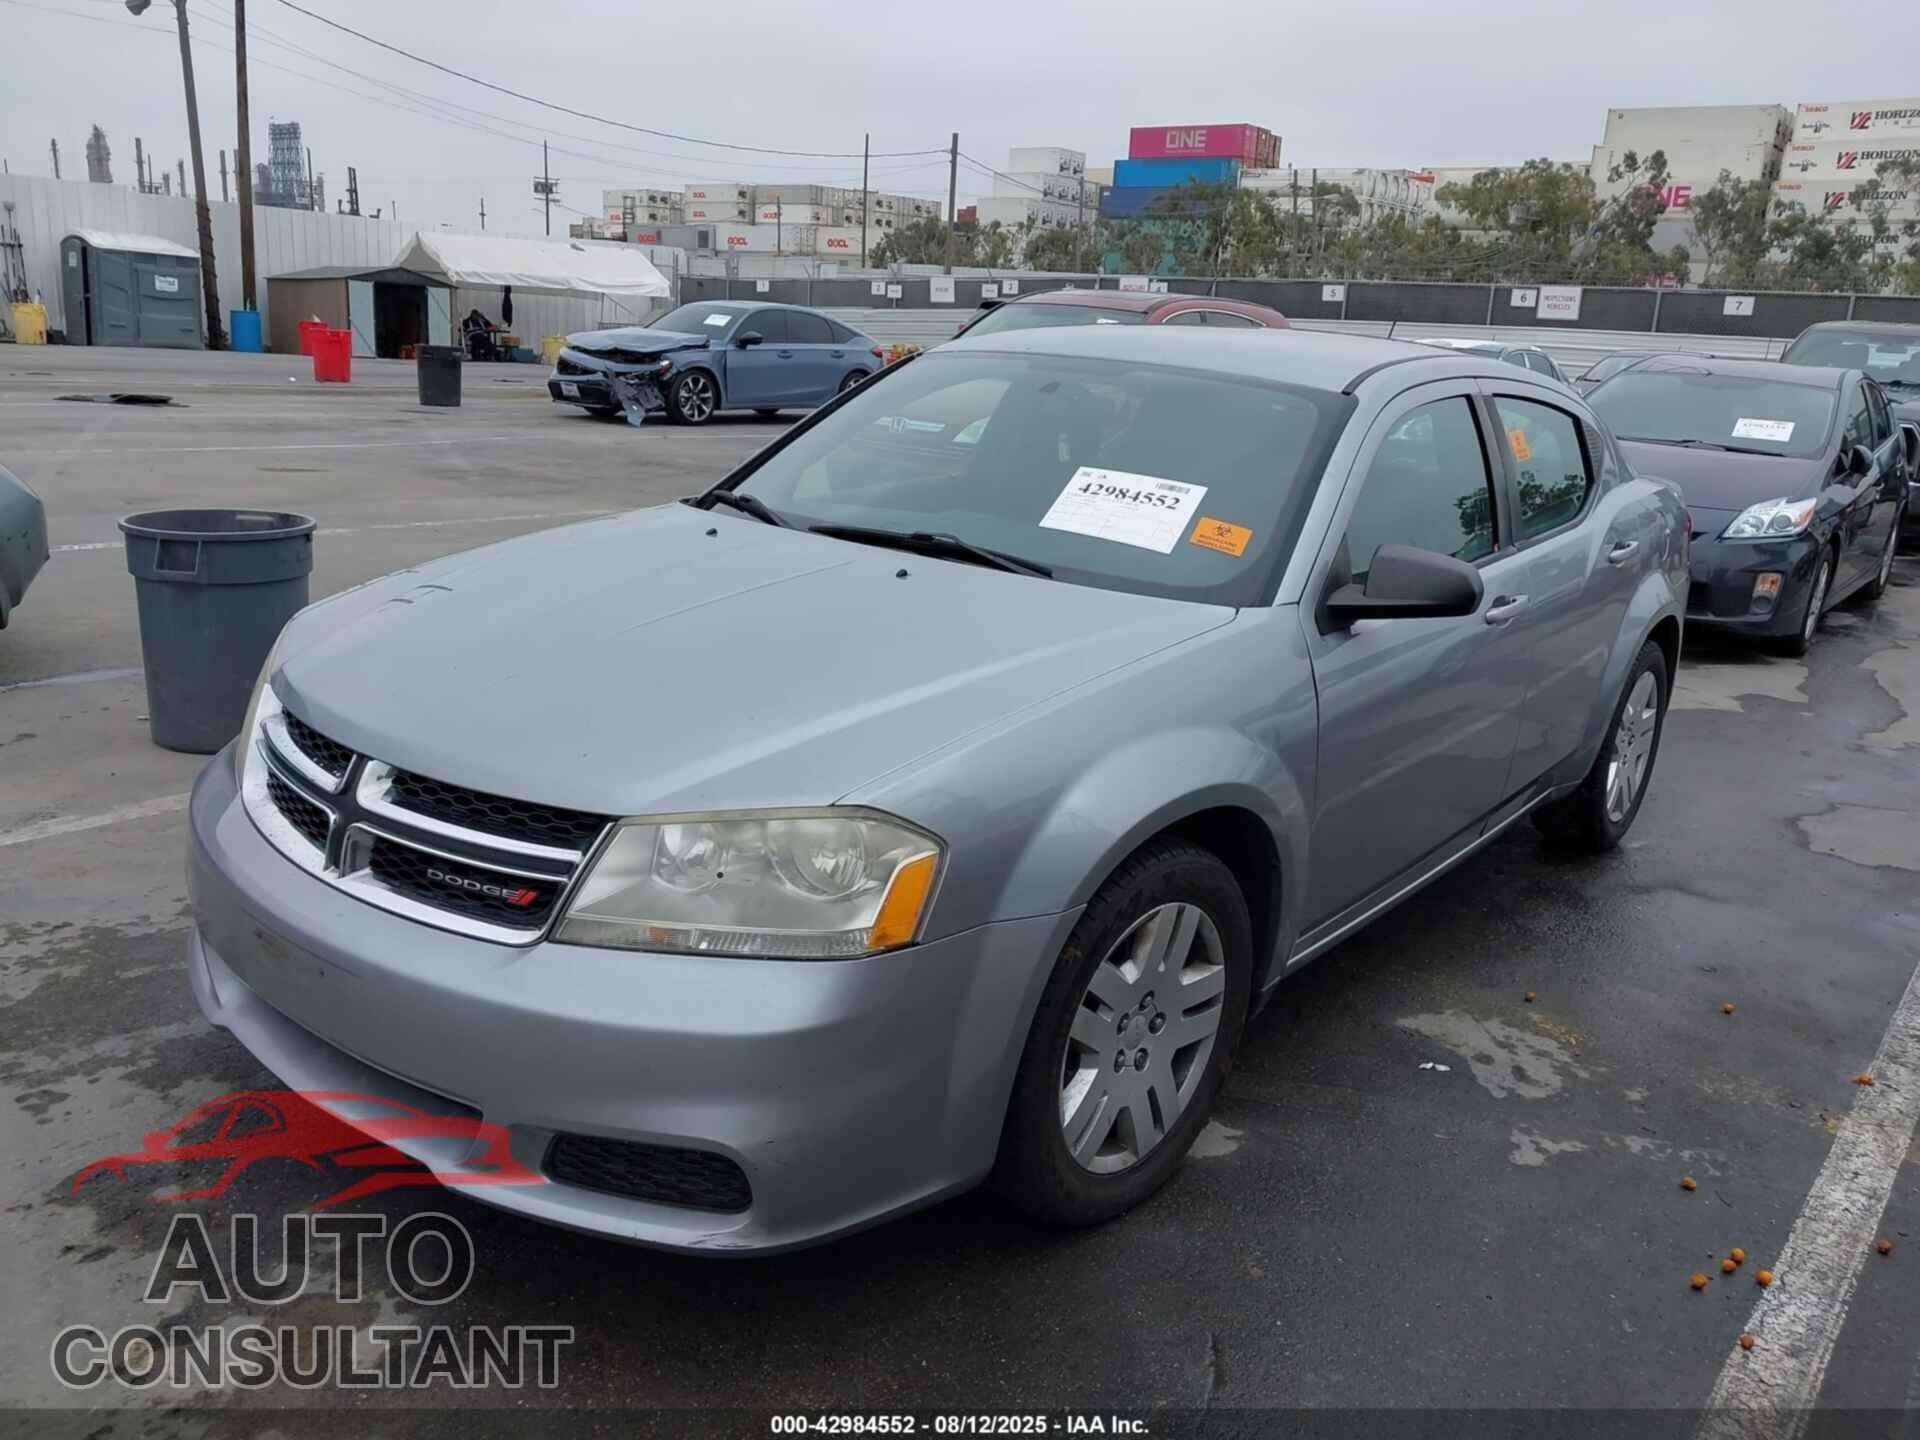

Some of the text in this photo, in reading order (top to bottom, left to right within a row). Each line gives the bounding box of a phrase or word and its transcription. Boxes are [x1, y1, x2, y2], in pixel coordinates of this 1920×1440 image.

[1166, 130, 1206, 148] ONE
[1329, 288, 1337, 298] 5
[1520, 293, 1528, 303] 6
[1735, 301, 1744, 311] 7
[1077, 482, 1181, 510] 42984552
[426, 868, 520, 898] DODGE
